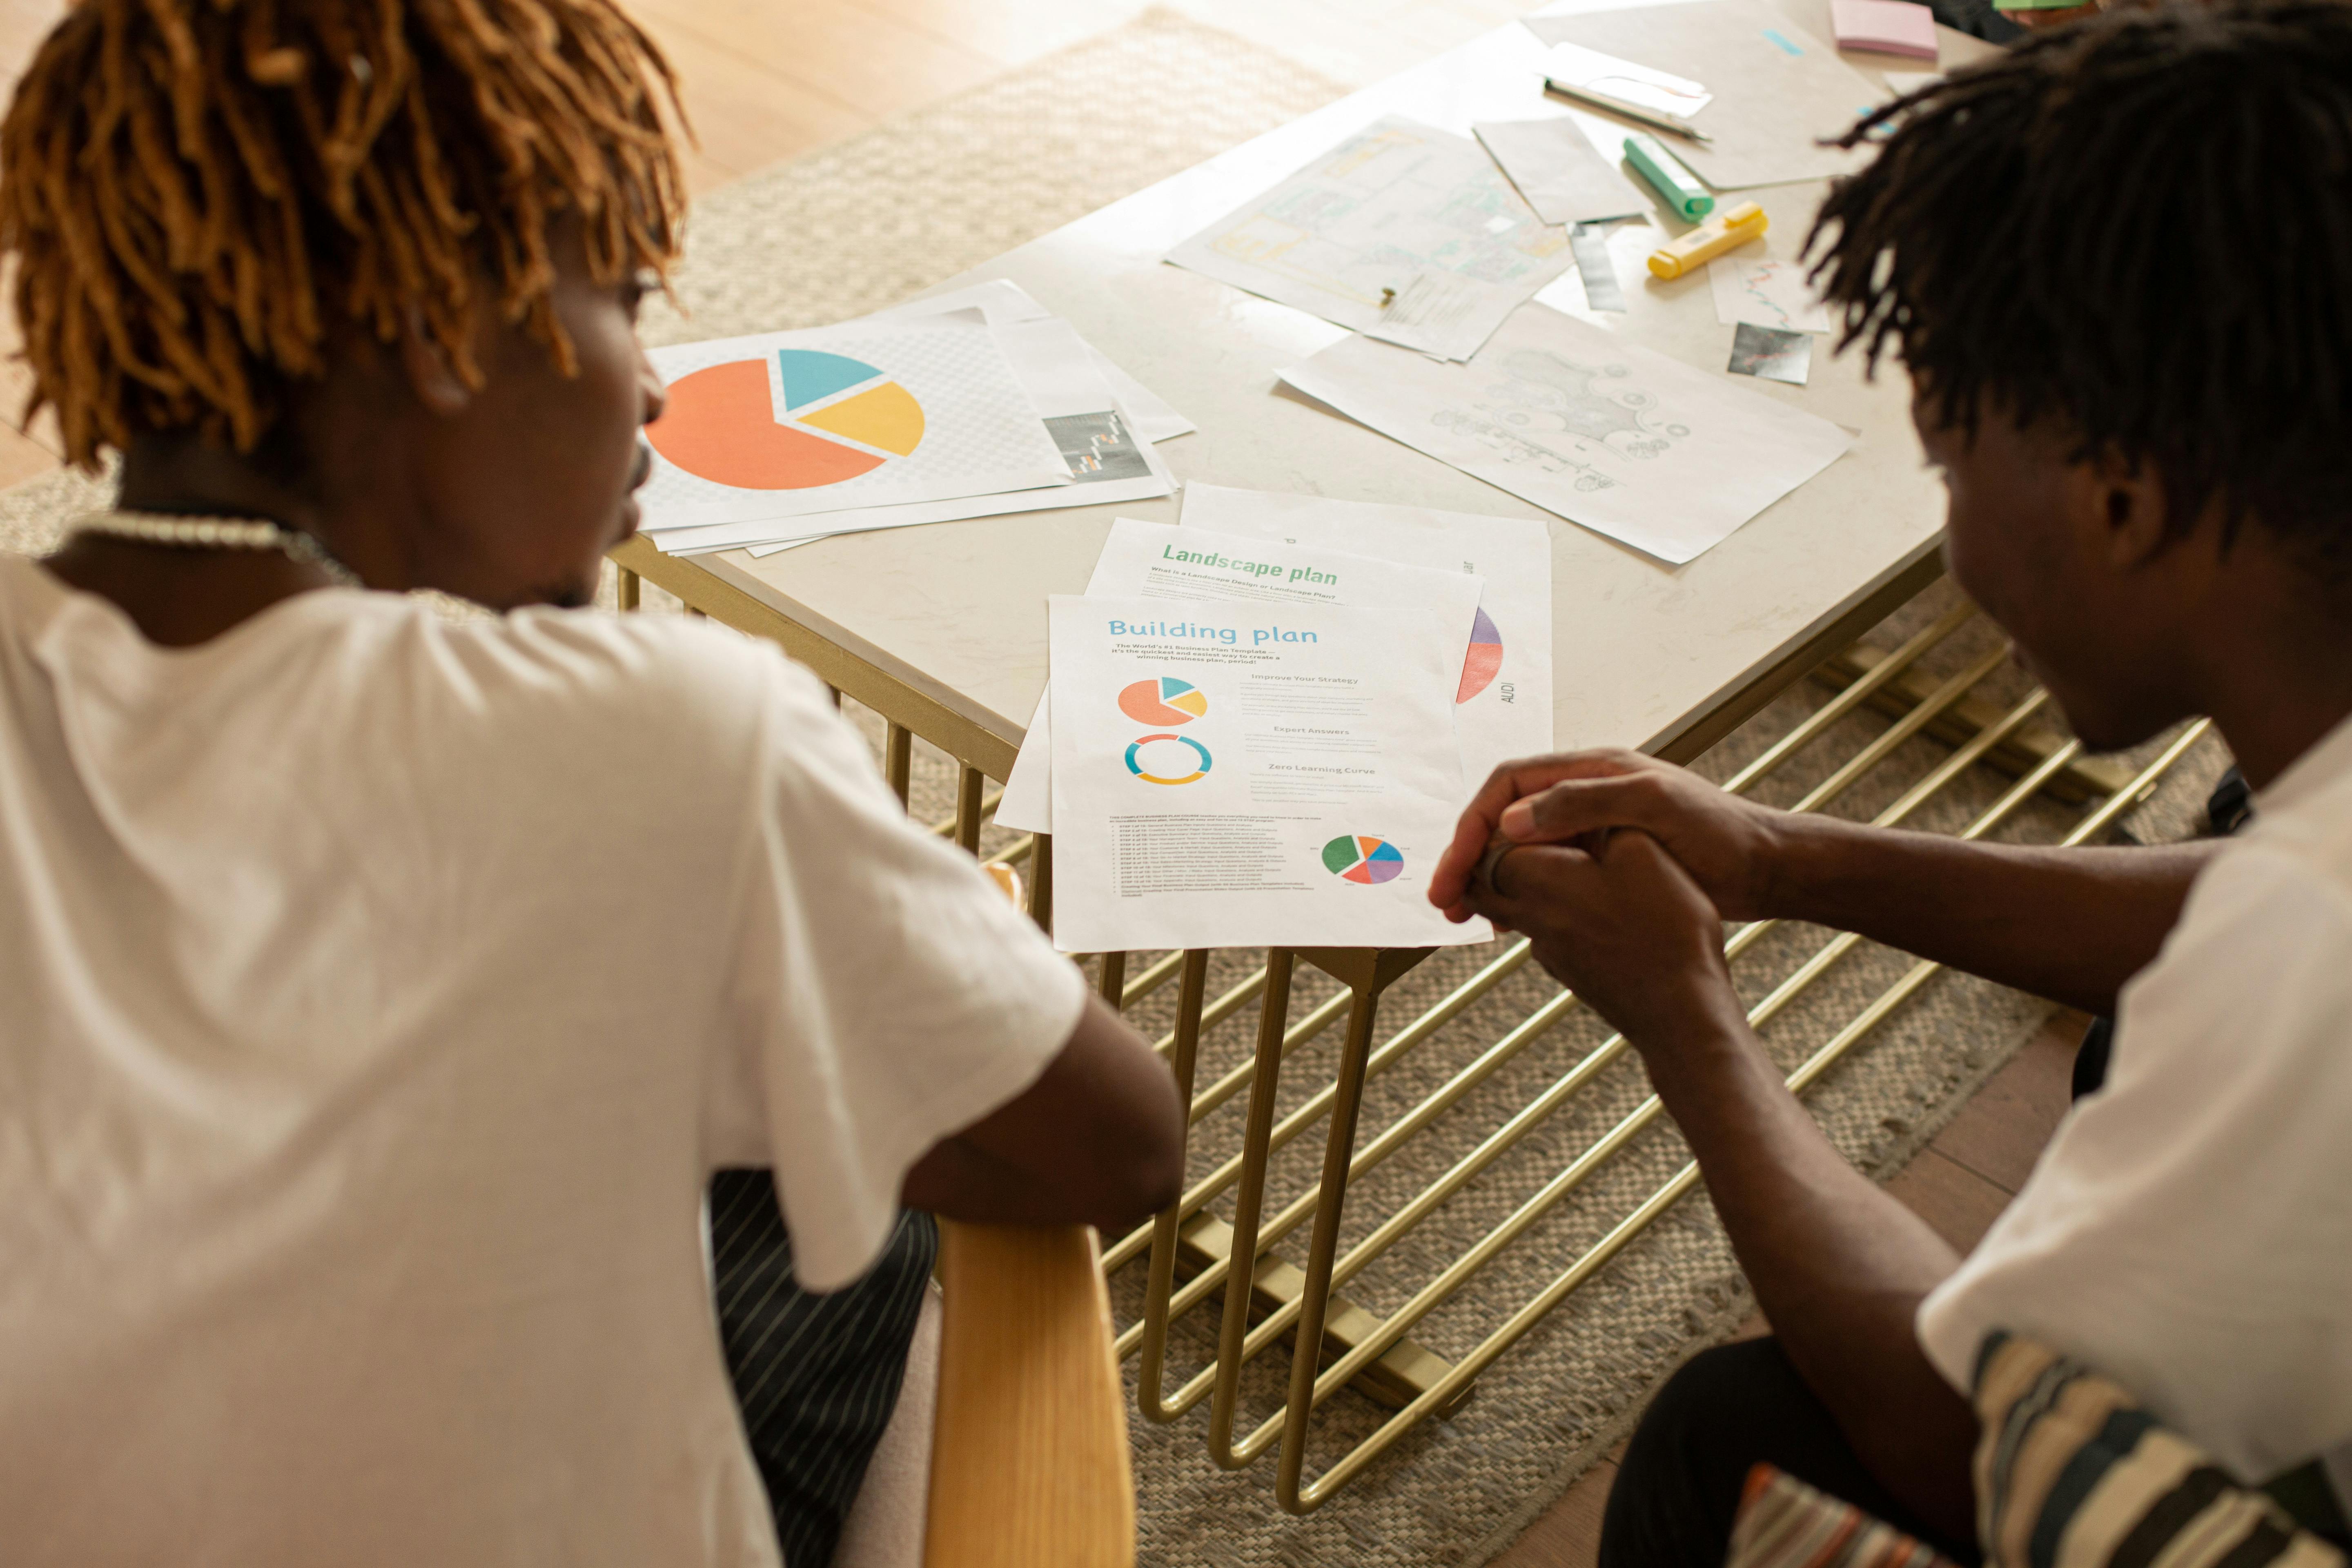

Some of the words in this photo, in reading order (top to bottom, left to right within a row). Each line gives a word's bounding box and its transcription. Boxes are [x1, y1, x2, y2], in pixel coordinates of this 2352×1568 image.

[1163, 544, 1283, 577] Landscape
[1289, 567, 1337, 586] plan
[1188, 572, 1230, 582] Landscape
[1232, 579, 1258, 587] Design
[1270, 586, 1312, 595] Landscape
[1108, 620, 1236, 644] Building
[1253, 626, 1317, 646] plan
[1501, 682, 1514, 704] AUDI
